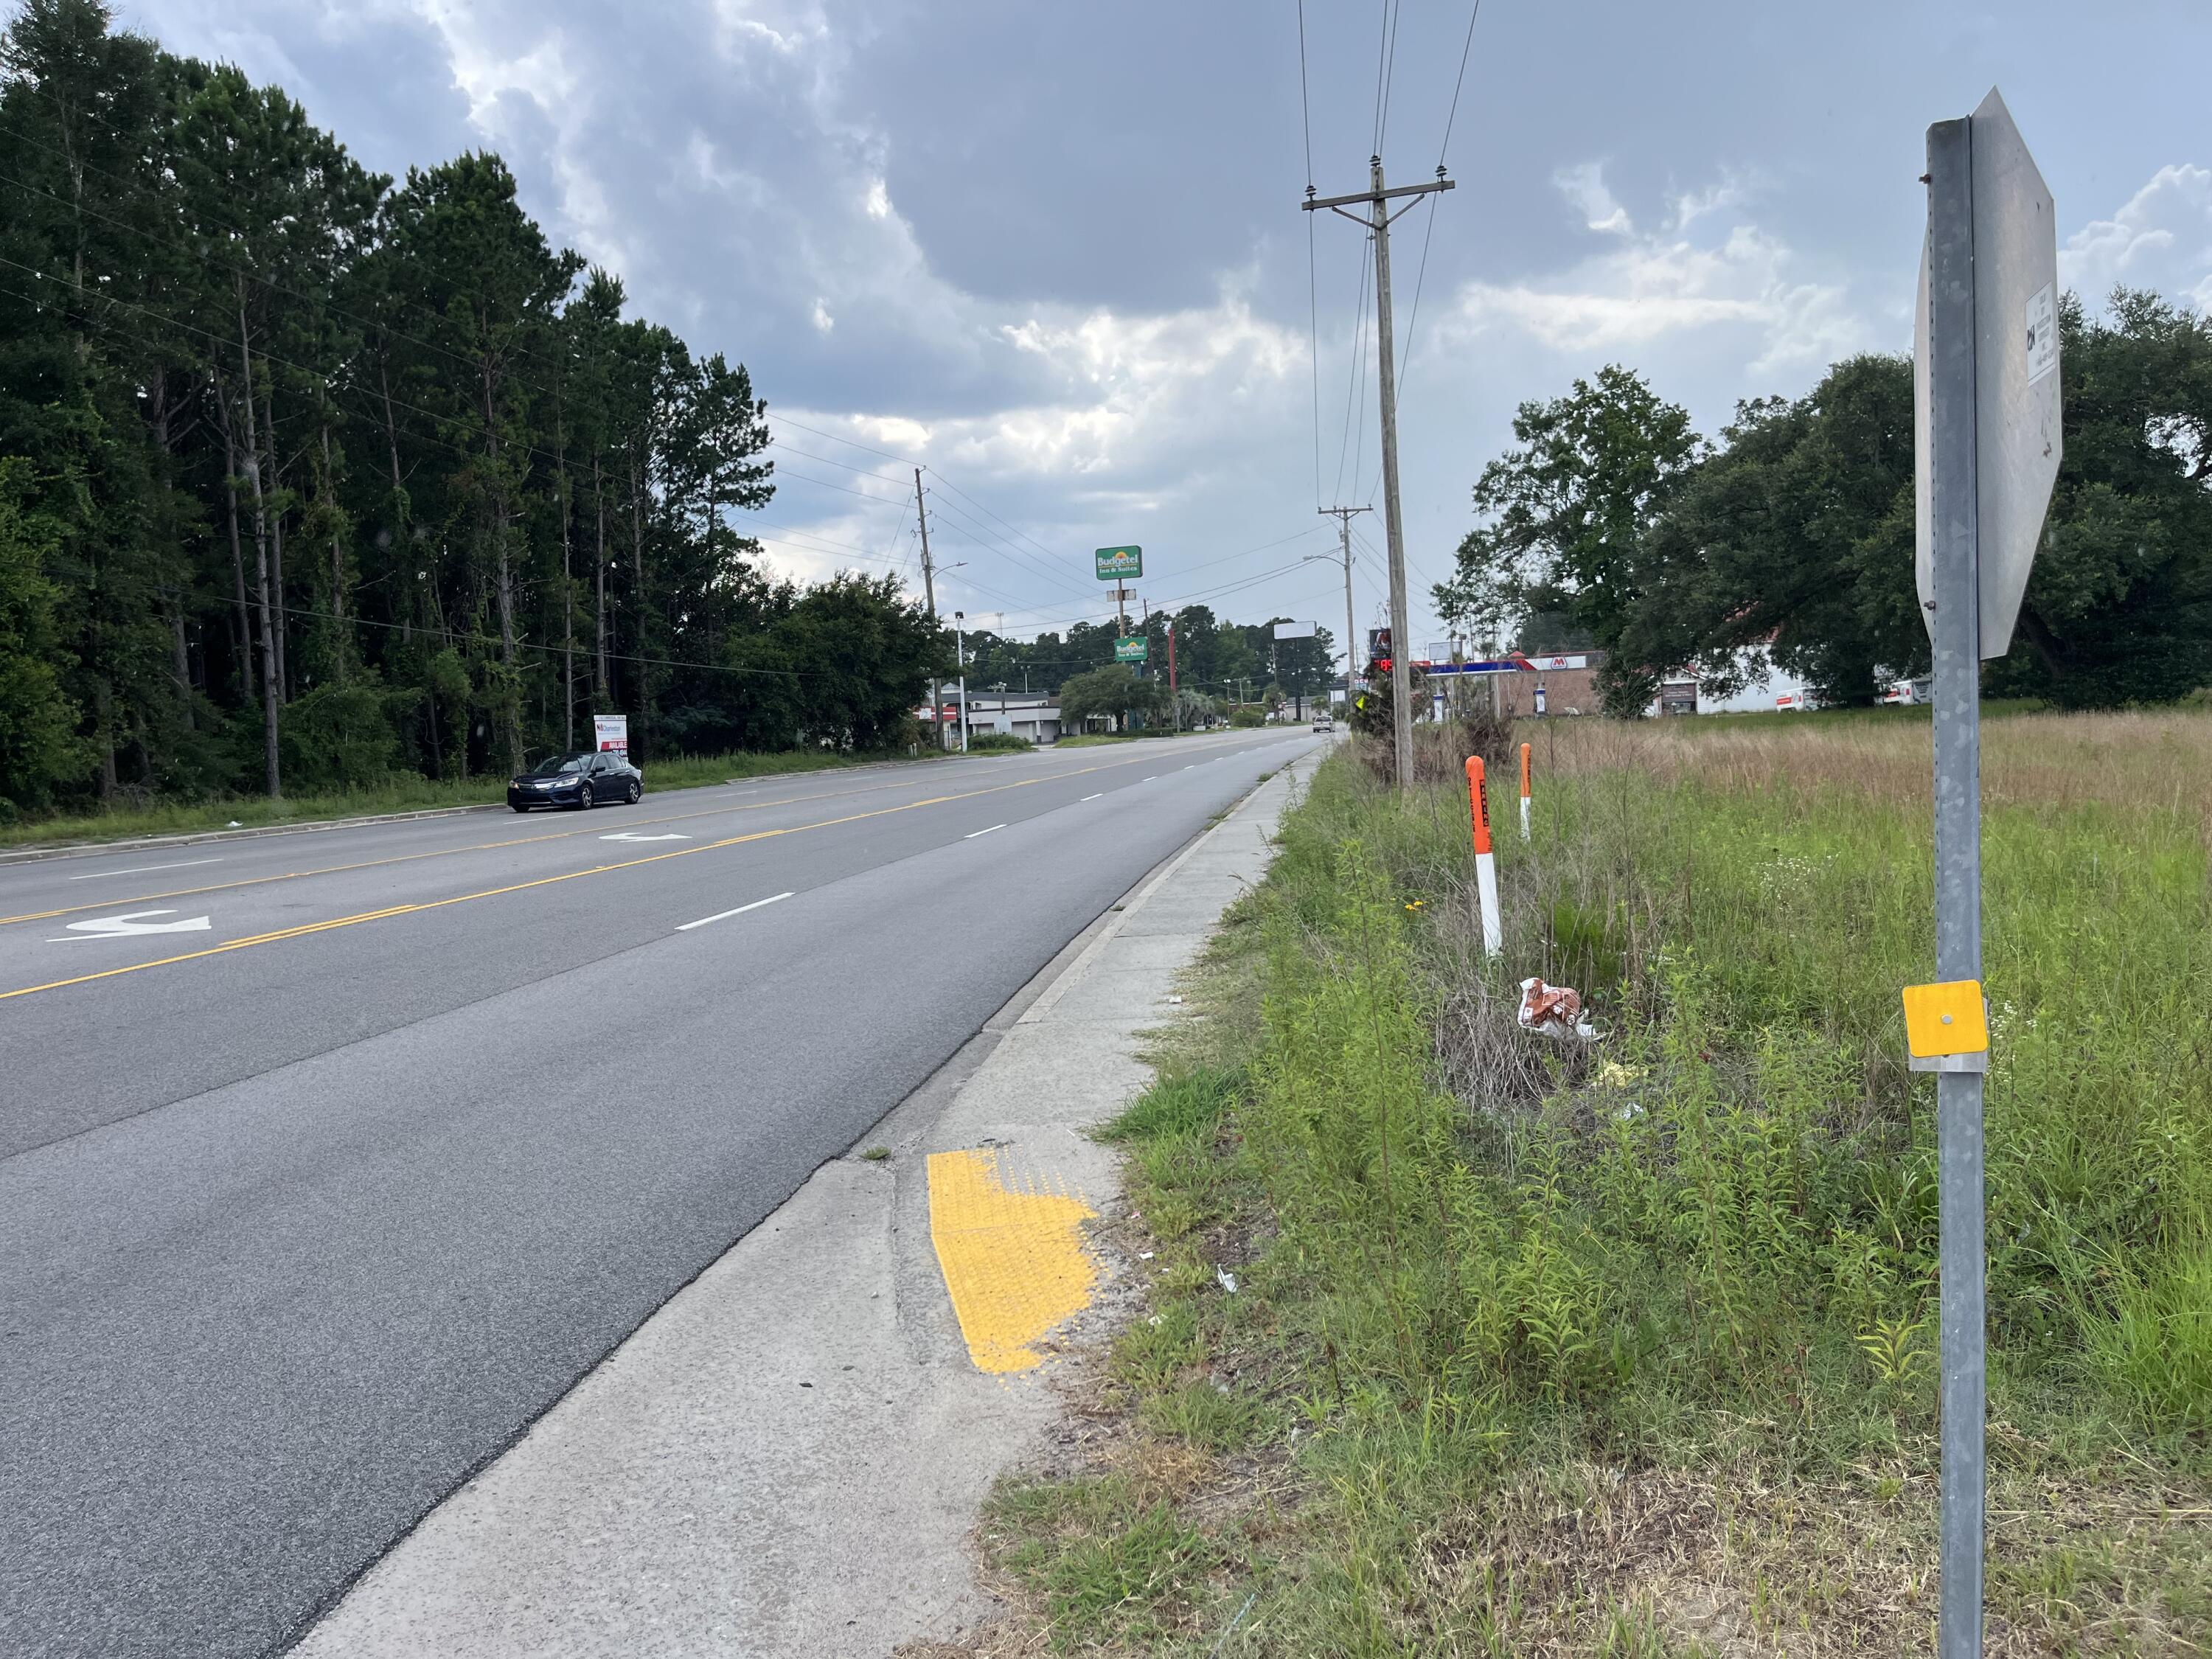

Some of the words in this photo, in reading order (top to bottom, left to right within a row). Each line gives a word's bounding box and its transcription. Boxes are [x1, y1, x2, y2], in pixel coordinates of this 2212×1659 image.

[1098, 554, 1138, 567] Budgetel
[1116, 644, 1144, 653] Budgetel
[1480, 779, 1489, 827] WARNING
